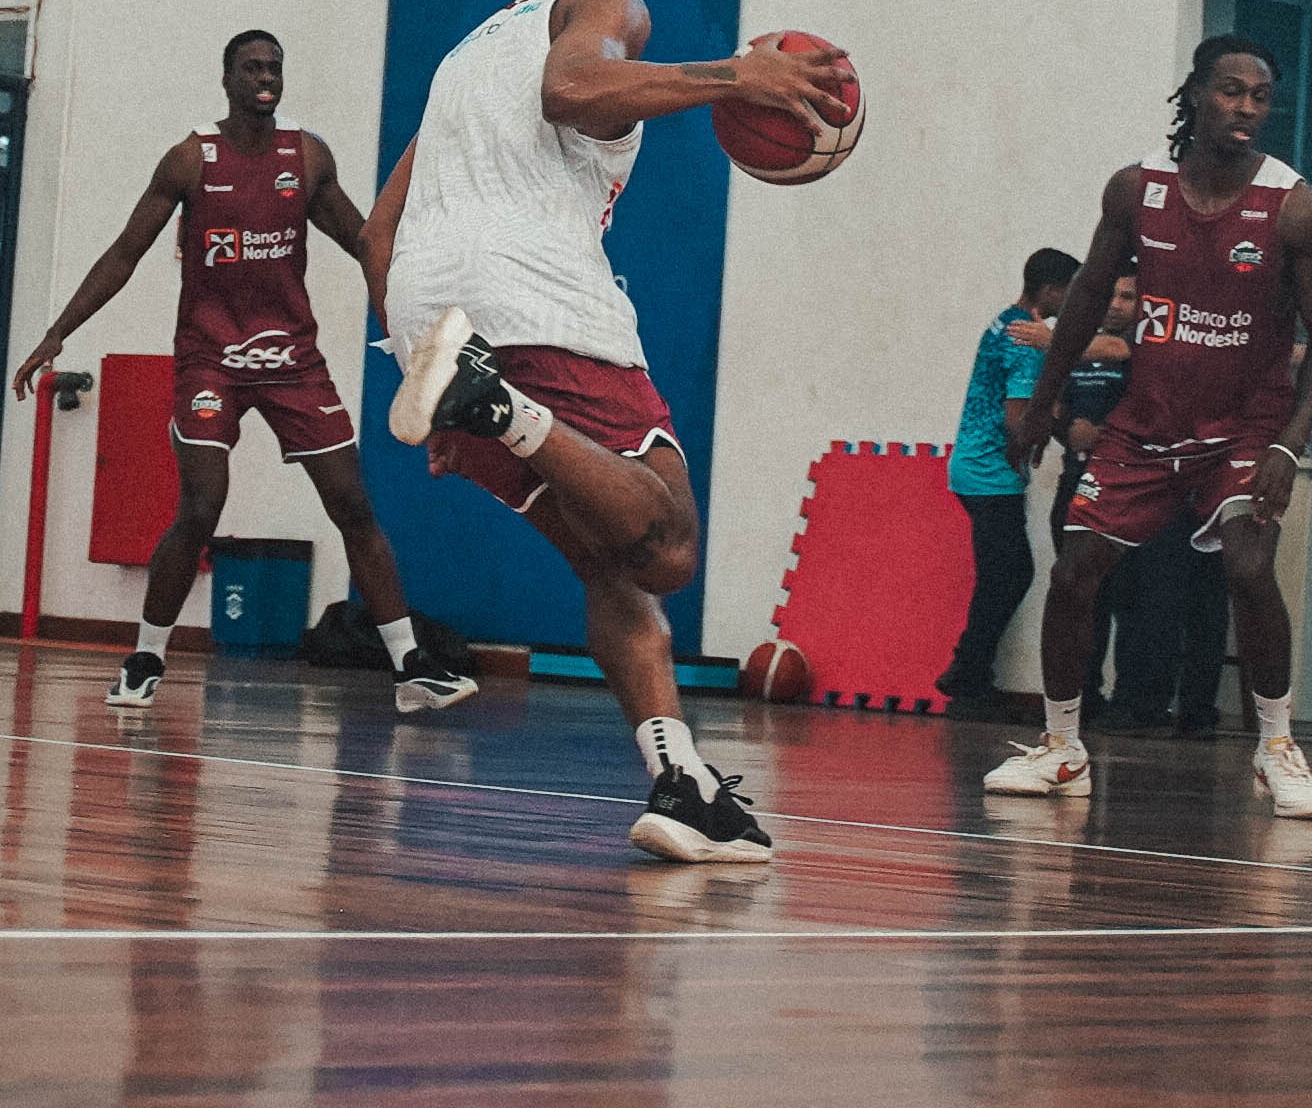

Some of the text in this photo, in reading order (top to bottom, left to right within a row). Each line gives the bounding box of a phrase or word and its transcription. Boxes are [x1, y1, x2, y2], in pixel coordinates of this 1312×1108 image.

[242, 230, 282, 245] Bano
[1178, 303, 1253, 328] Banco do
[1174, 323, 1250, 347] Nordeste
[220, 330, 297, 369] Sesc
